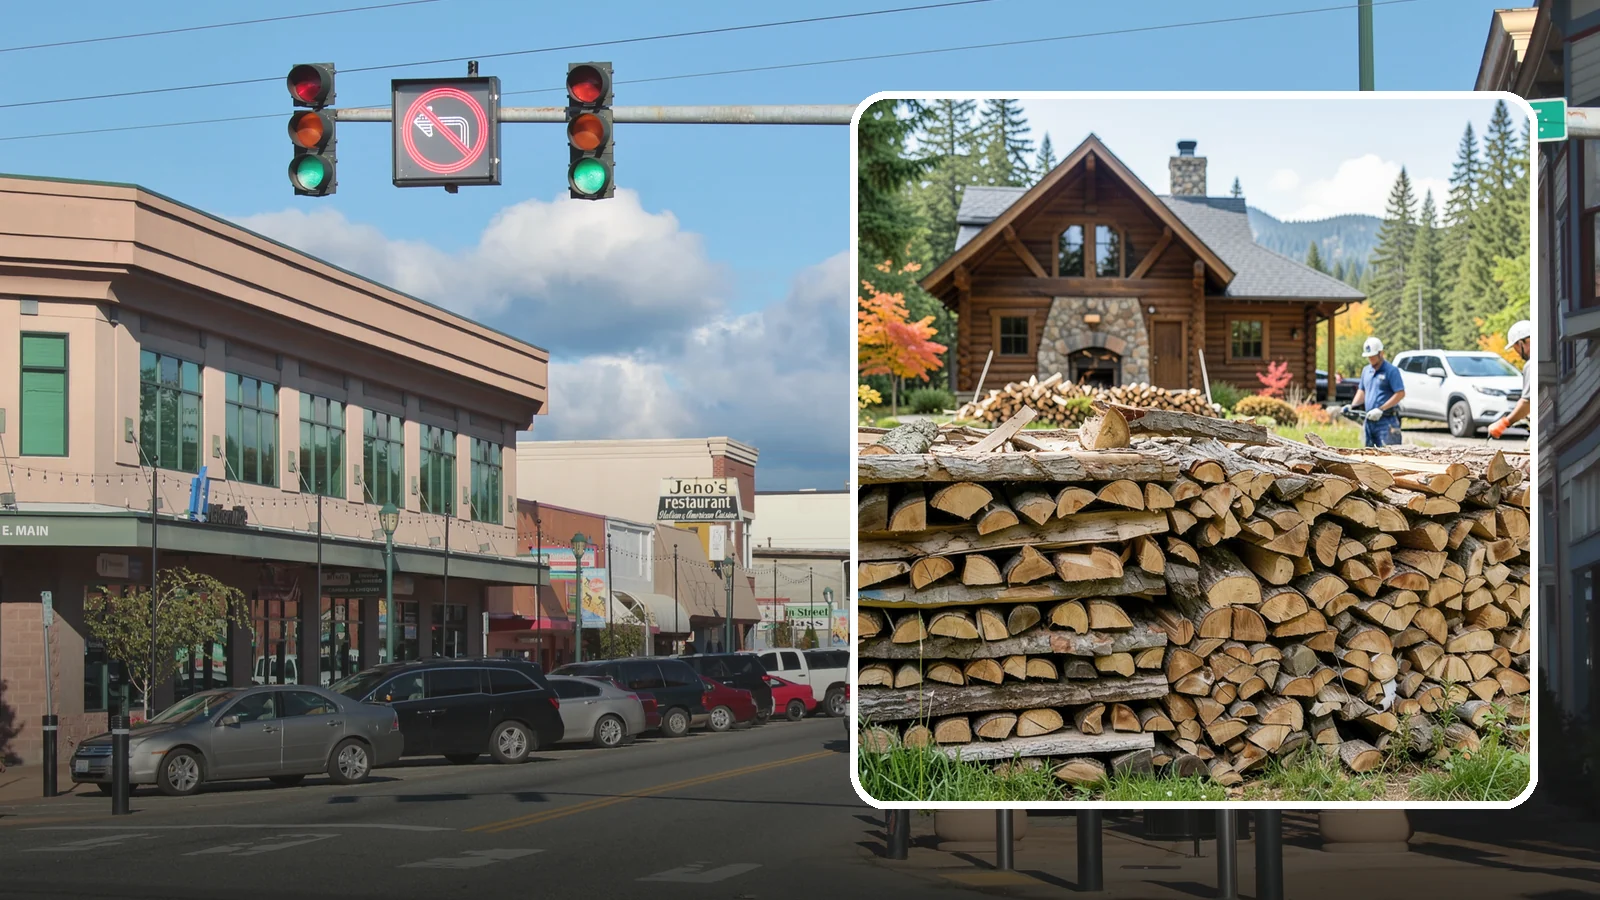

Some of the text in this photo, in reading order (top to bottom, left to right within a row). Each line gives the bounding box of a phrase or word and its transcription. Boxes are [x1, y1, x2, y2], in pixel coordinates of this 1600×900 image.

[669, 480, 727, 494] Jeno's
[665, 496, 730, 508] restaurant
[658, 510, 681, 519] Italian
[686, 510, 714, 519] American
[715, 510, 738, 519] Cuisine
[2, 525, 48, 536] E. MAIN
[786, 608, 794, 616] in
[798, 608, 828, 616] Street
[790, 618, 824, 626] lass
